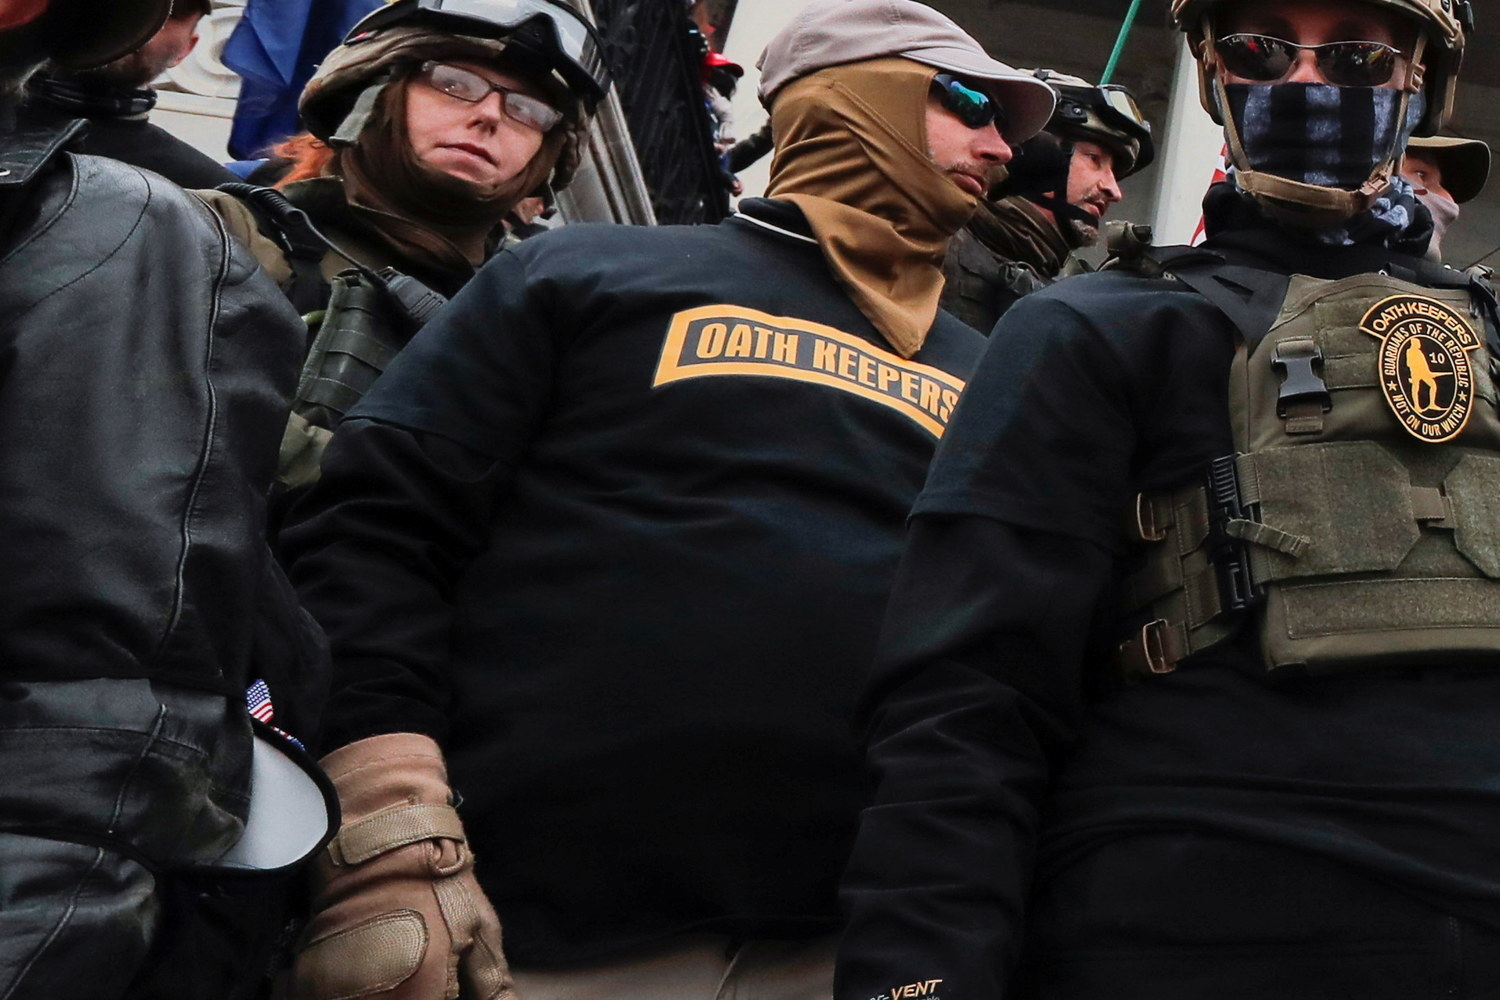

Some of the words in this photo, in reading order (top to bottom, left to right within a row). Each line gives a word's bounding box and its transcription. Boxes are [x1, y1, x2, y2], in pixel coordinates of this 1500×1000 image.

[695, 323, 799, 364] OATH
[812, 338, 959, 423] KEEPERS
[1384, 327, 1409, 376] GUARDIANS
[1409, 323, 1423, 334] OF
[1426, 324, 1447, 341] THE
[1444, 340, 1469, 388] REPUBLIC
[1429, 352, 1445, 364] 10
[1392, 394, 1410, 415] NOT
[1406, 414, 1420, 430] ON
[1422, 423, 1441, 436] OUR
[1440, 403, 1466, 433] WATCH
